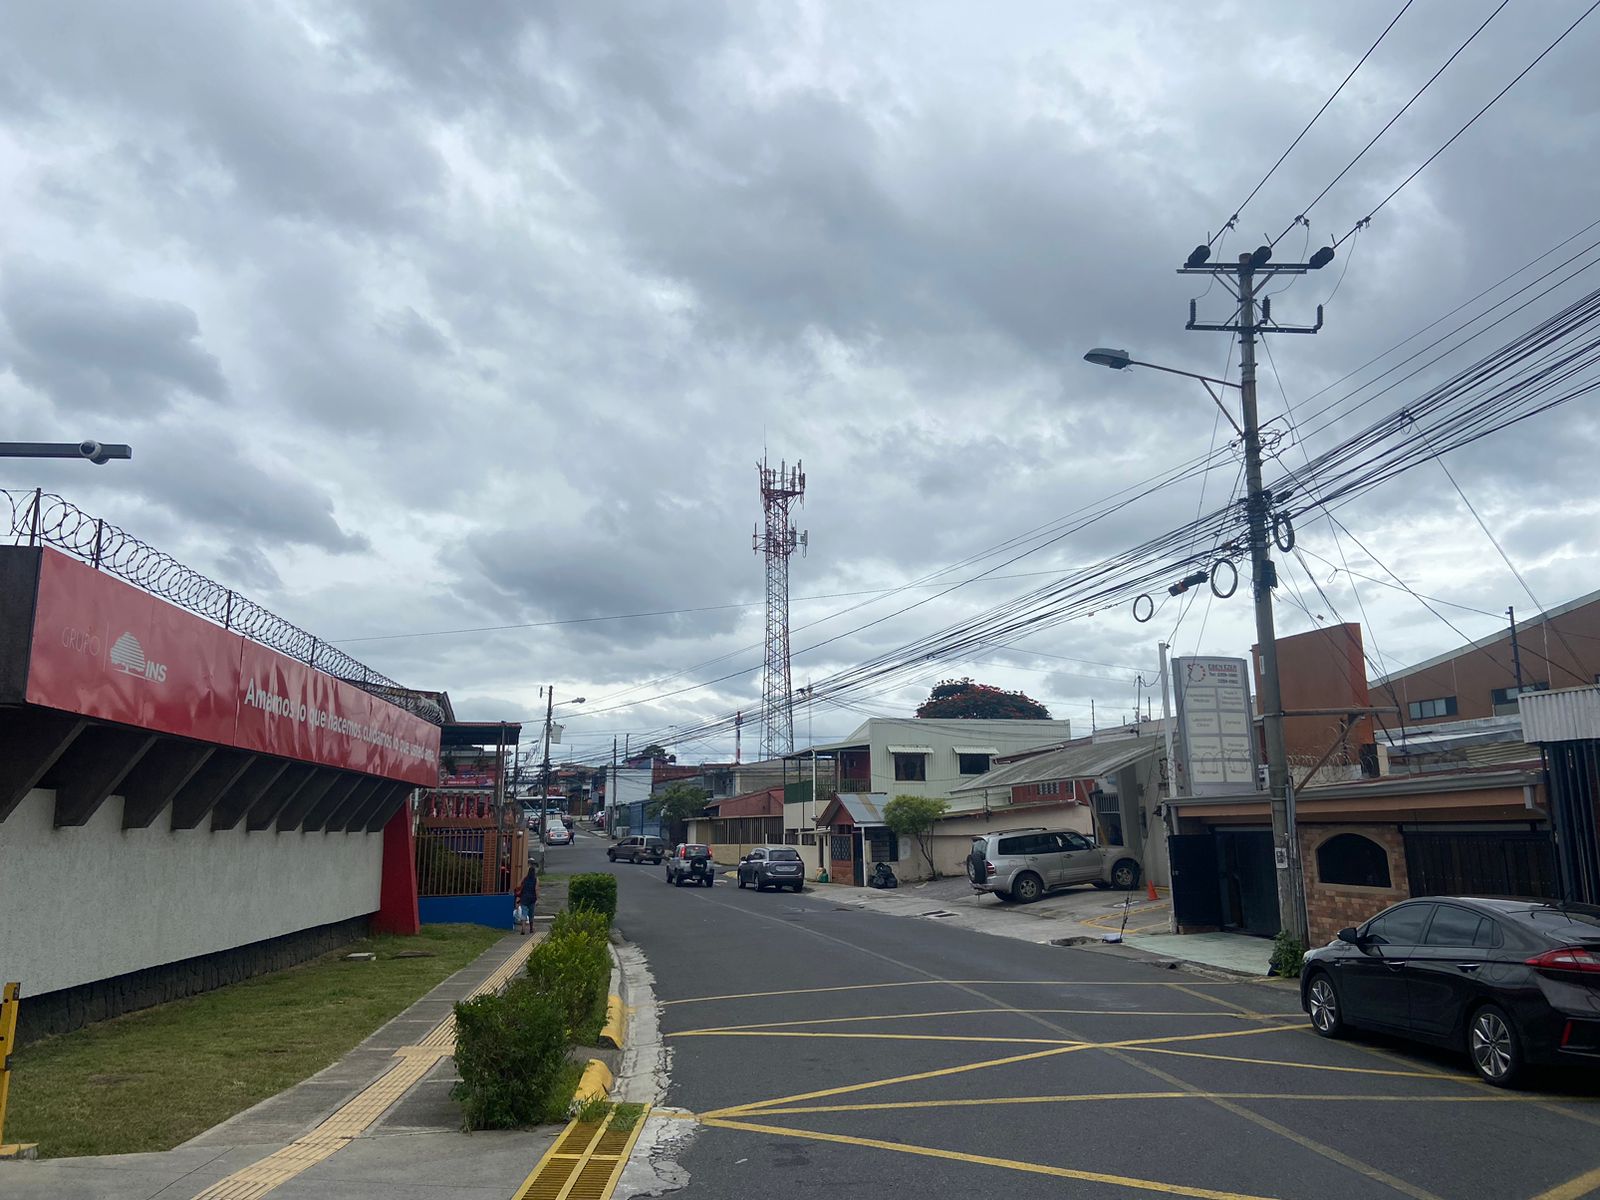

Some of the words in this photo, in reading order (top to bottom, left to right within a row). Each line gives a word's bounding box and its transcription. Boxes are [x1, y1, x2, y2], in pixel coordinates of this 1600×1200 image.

[62, 627, 100, 656] GRUPO
[144, 660, 168, 682] INS
[244, 678, 294, 719] Amamos
[296, 704, 307, 722] lo
[309, 706, 326, 732] que
